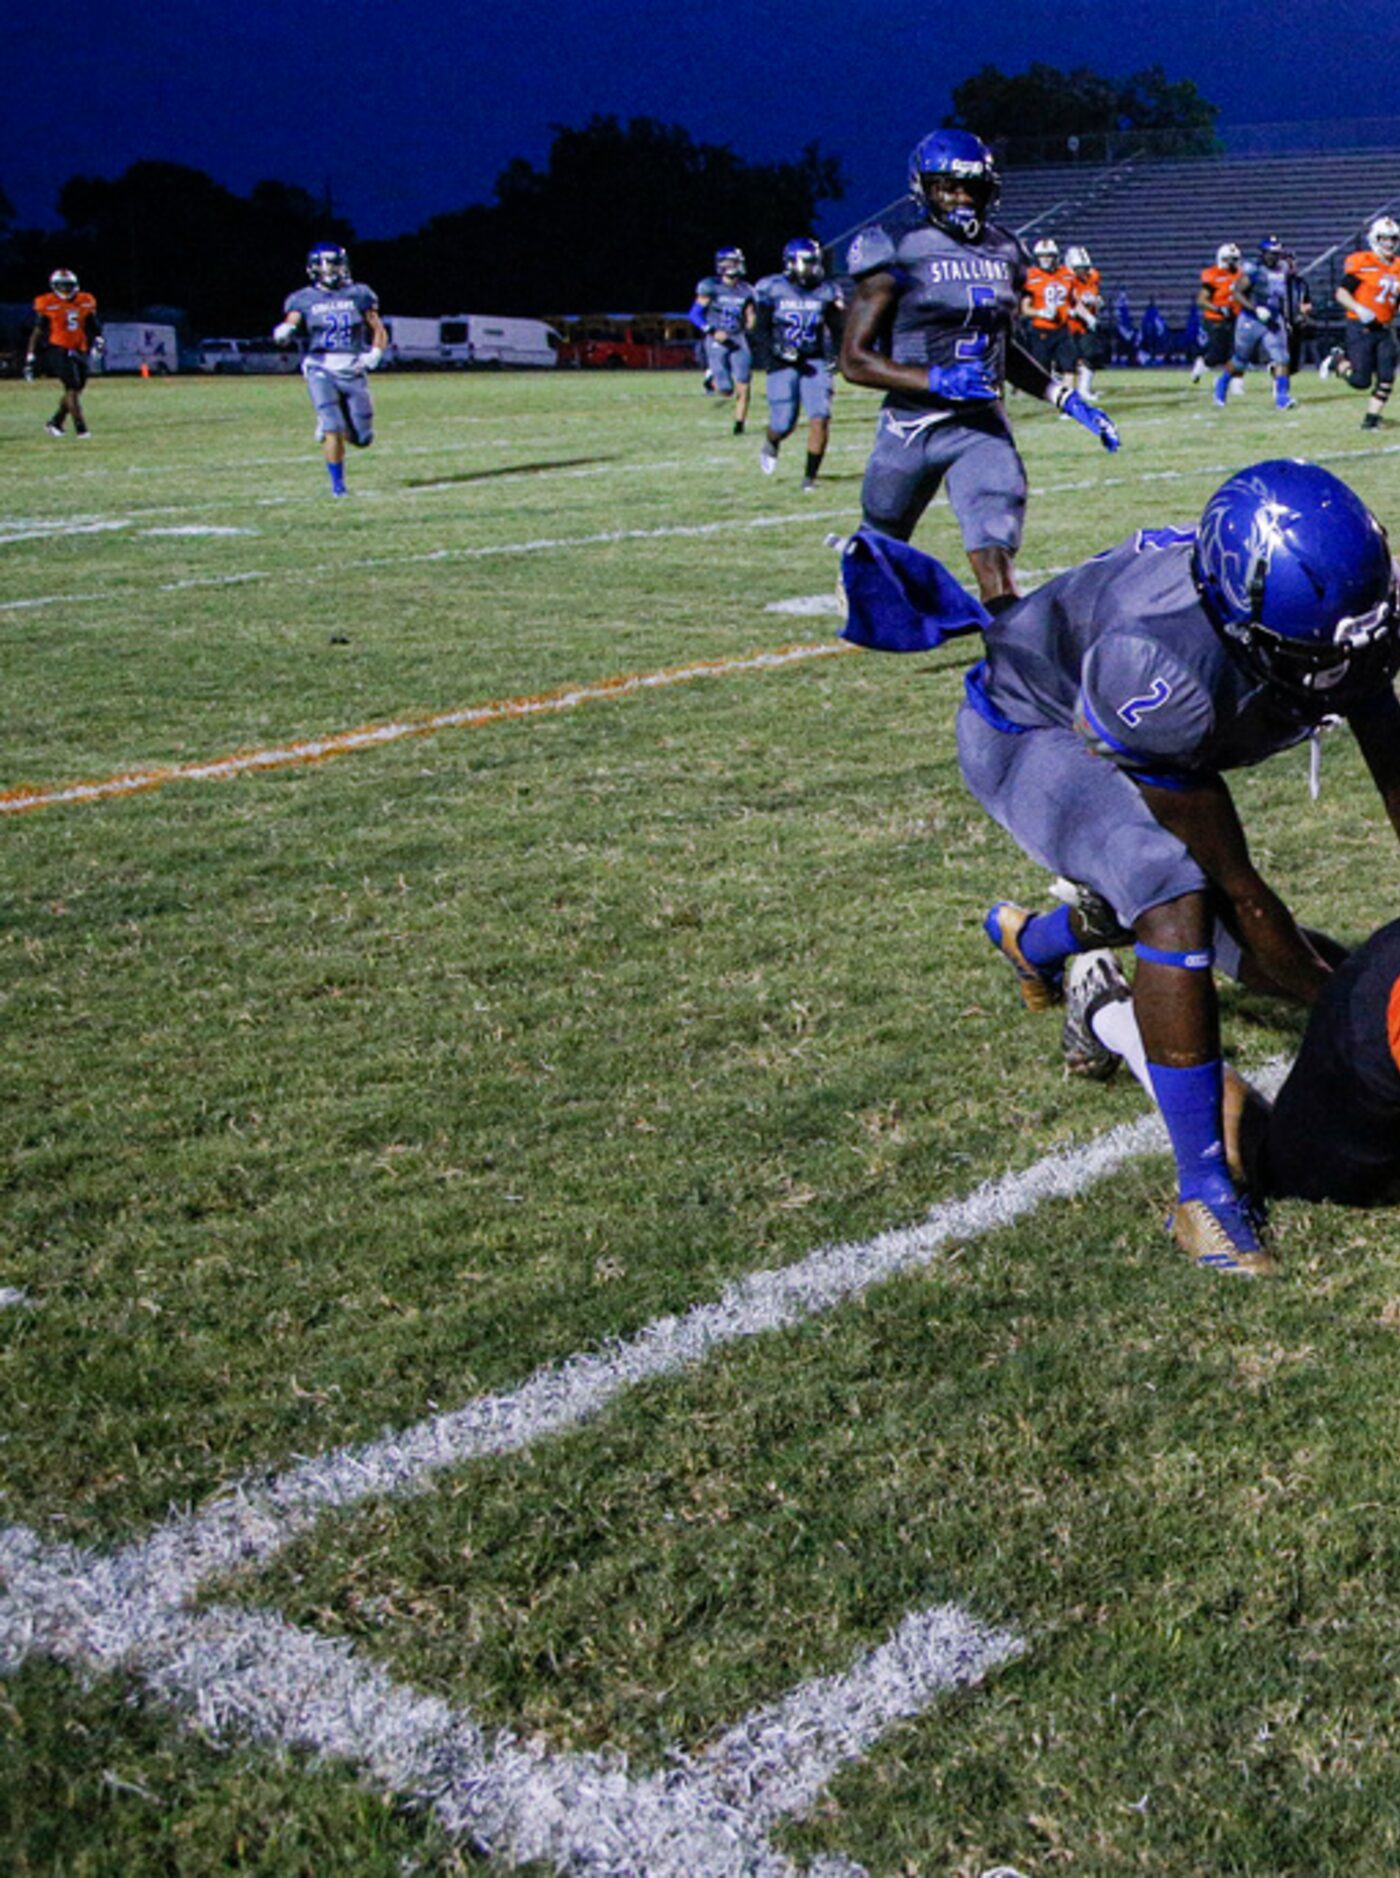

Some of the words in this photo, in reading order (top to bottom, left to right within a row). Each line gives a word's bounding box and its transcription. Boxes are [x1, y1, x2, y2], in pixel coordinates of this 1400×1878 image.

[929, 259, 1010, 283] STALLIONS
[65, 309, 80, 332] 5
[1116, 676, 1173, 729] 2
